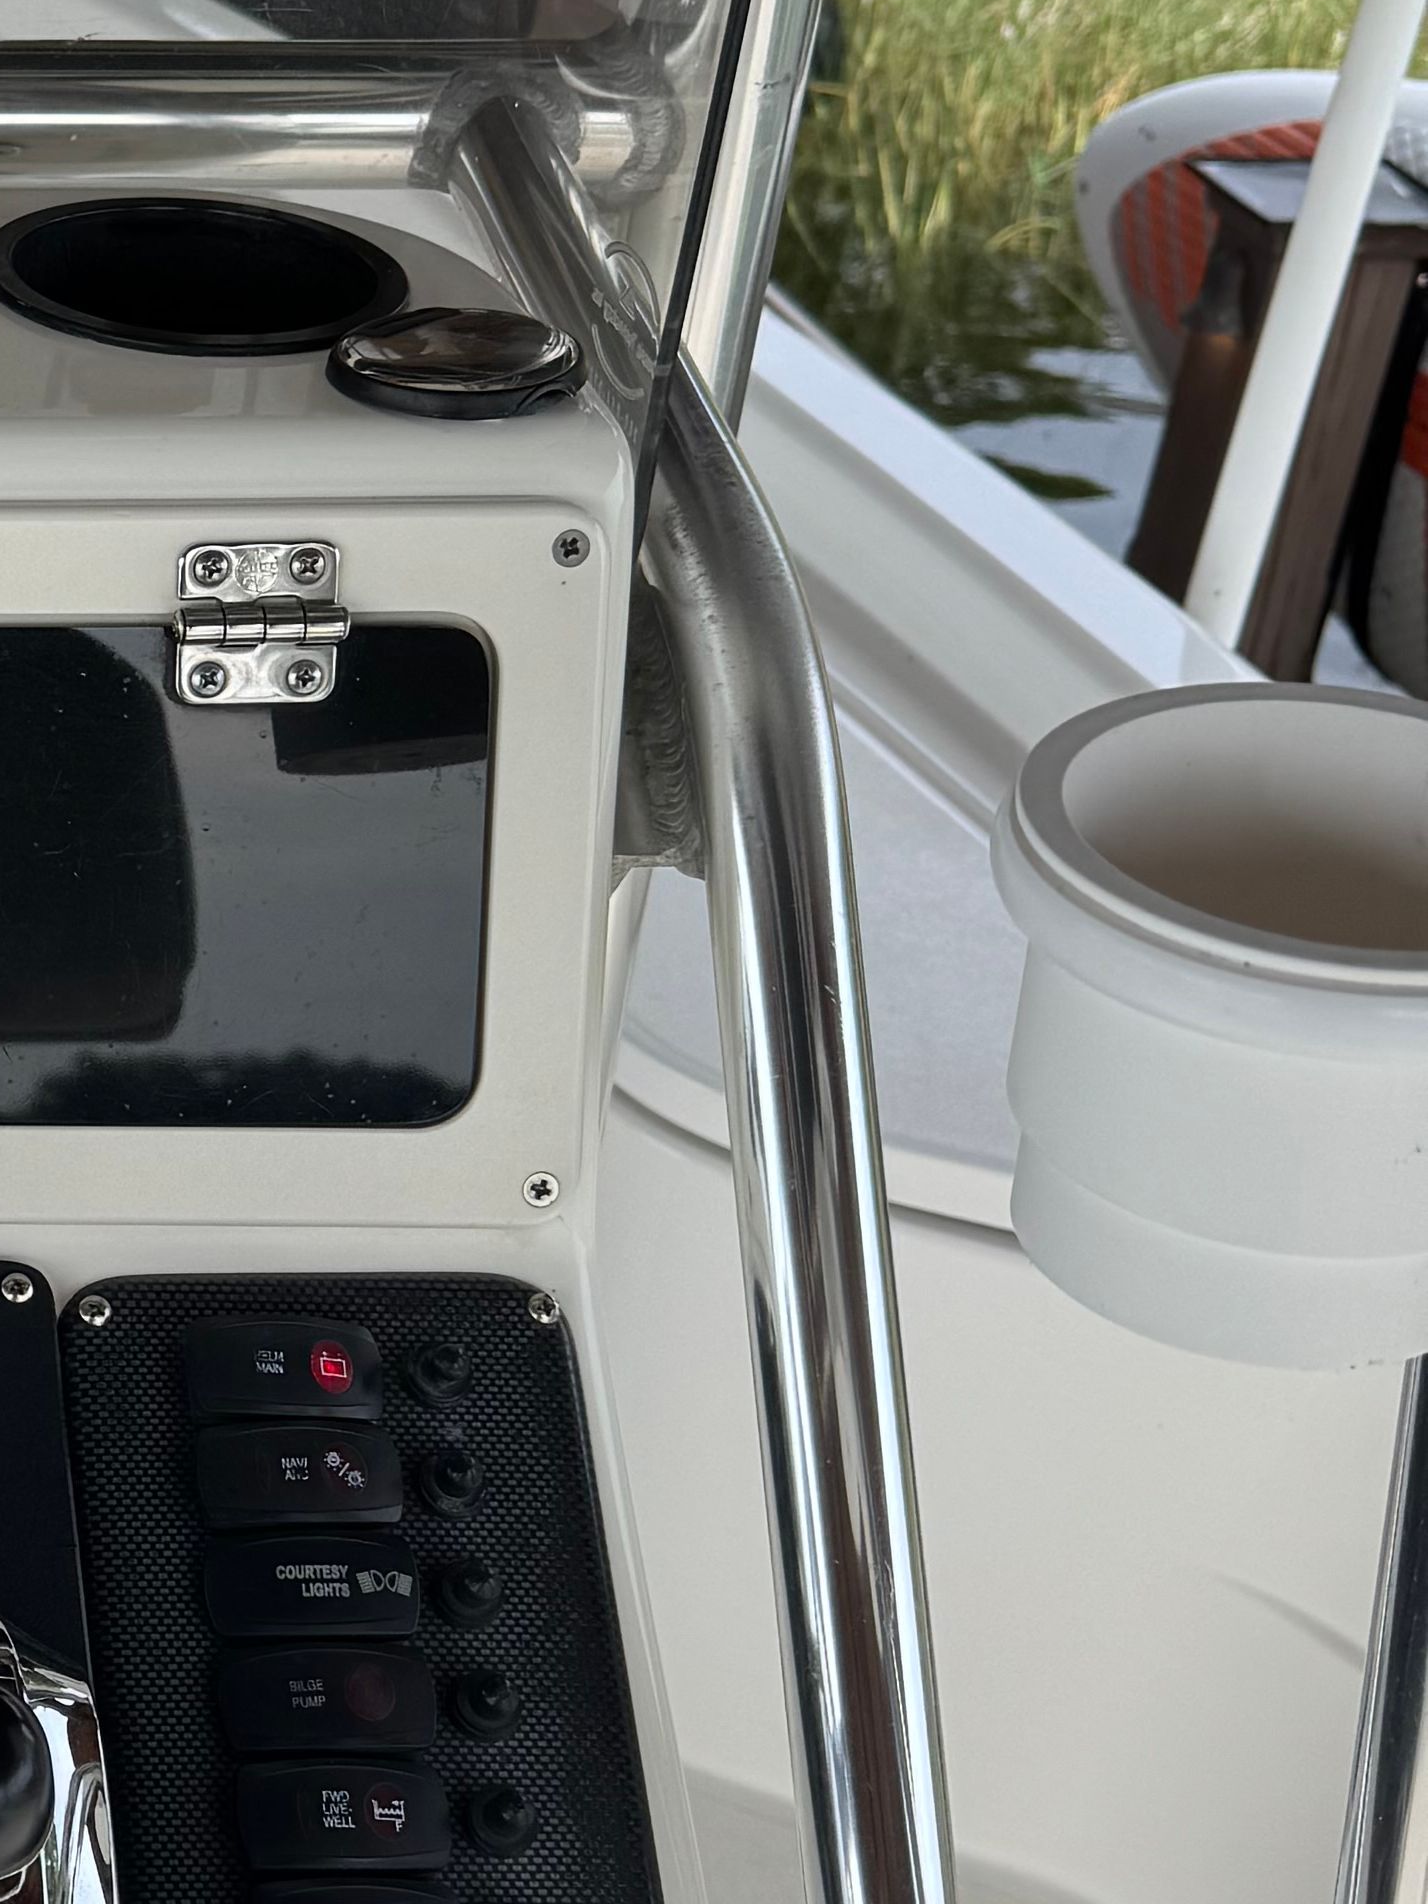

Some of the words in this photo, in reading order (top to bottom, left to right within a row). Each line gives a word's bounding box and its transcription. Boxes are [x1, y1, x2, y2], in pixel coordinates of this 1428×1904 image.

[275, 1564, 350, 1581] COURTESY
[301, 1581, 351, 1598] LIGHTS
[288, 1678, 325, 1693] BILGE
[291, 1694, 326, 1710] PUMP
[322, 1815, 357, 1829] WELL
